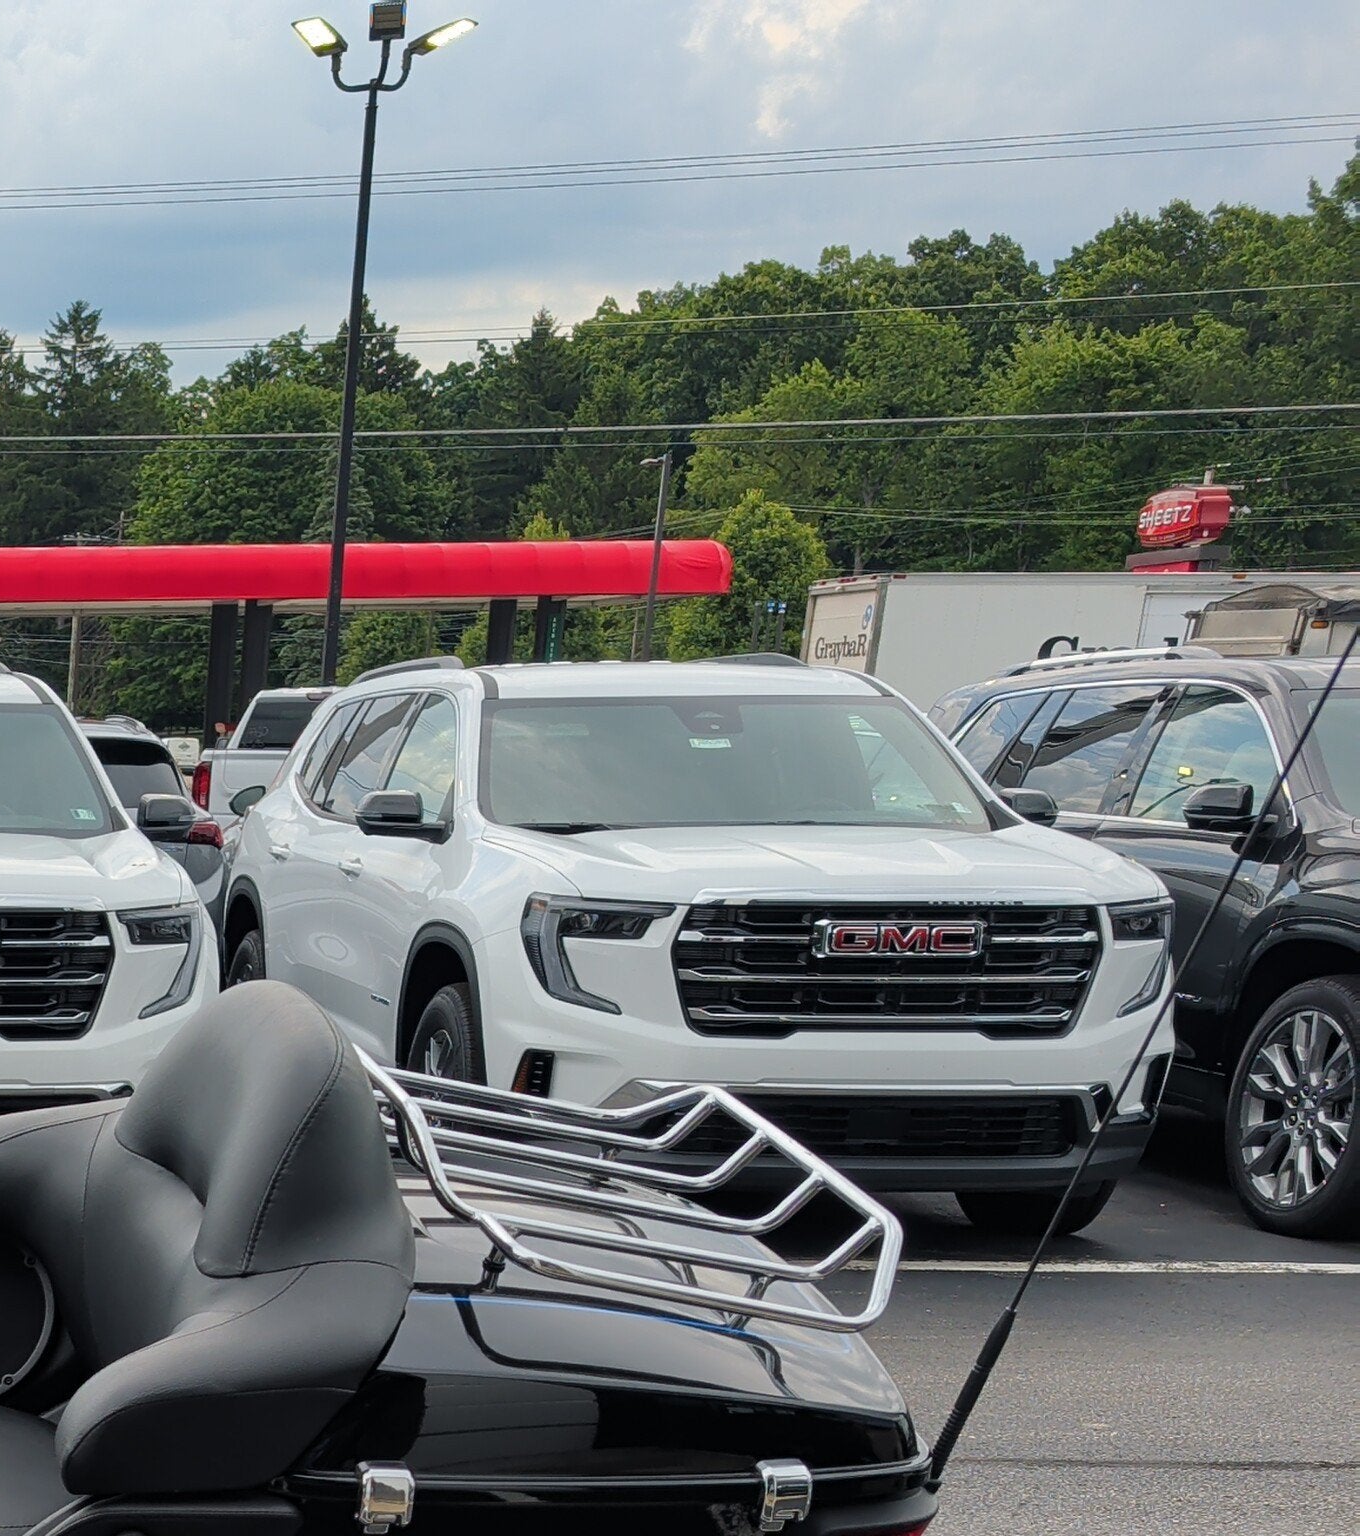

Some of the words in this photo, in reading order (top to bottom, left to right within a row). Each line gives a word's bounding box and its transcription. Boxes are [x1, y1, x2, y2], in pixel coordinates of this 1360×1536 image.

[1138, 505, 1193, 529] SHEETZ
[815, 634, 867, 665] GraybaR
[832, 926, 976, 952] GMC
